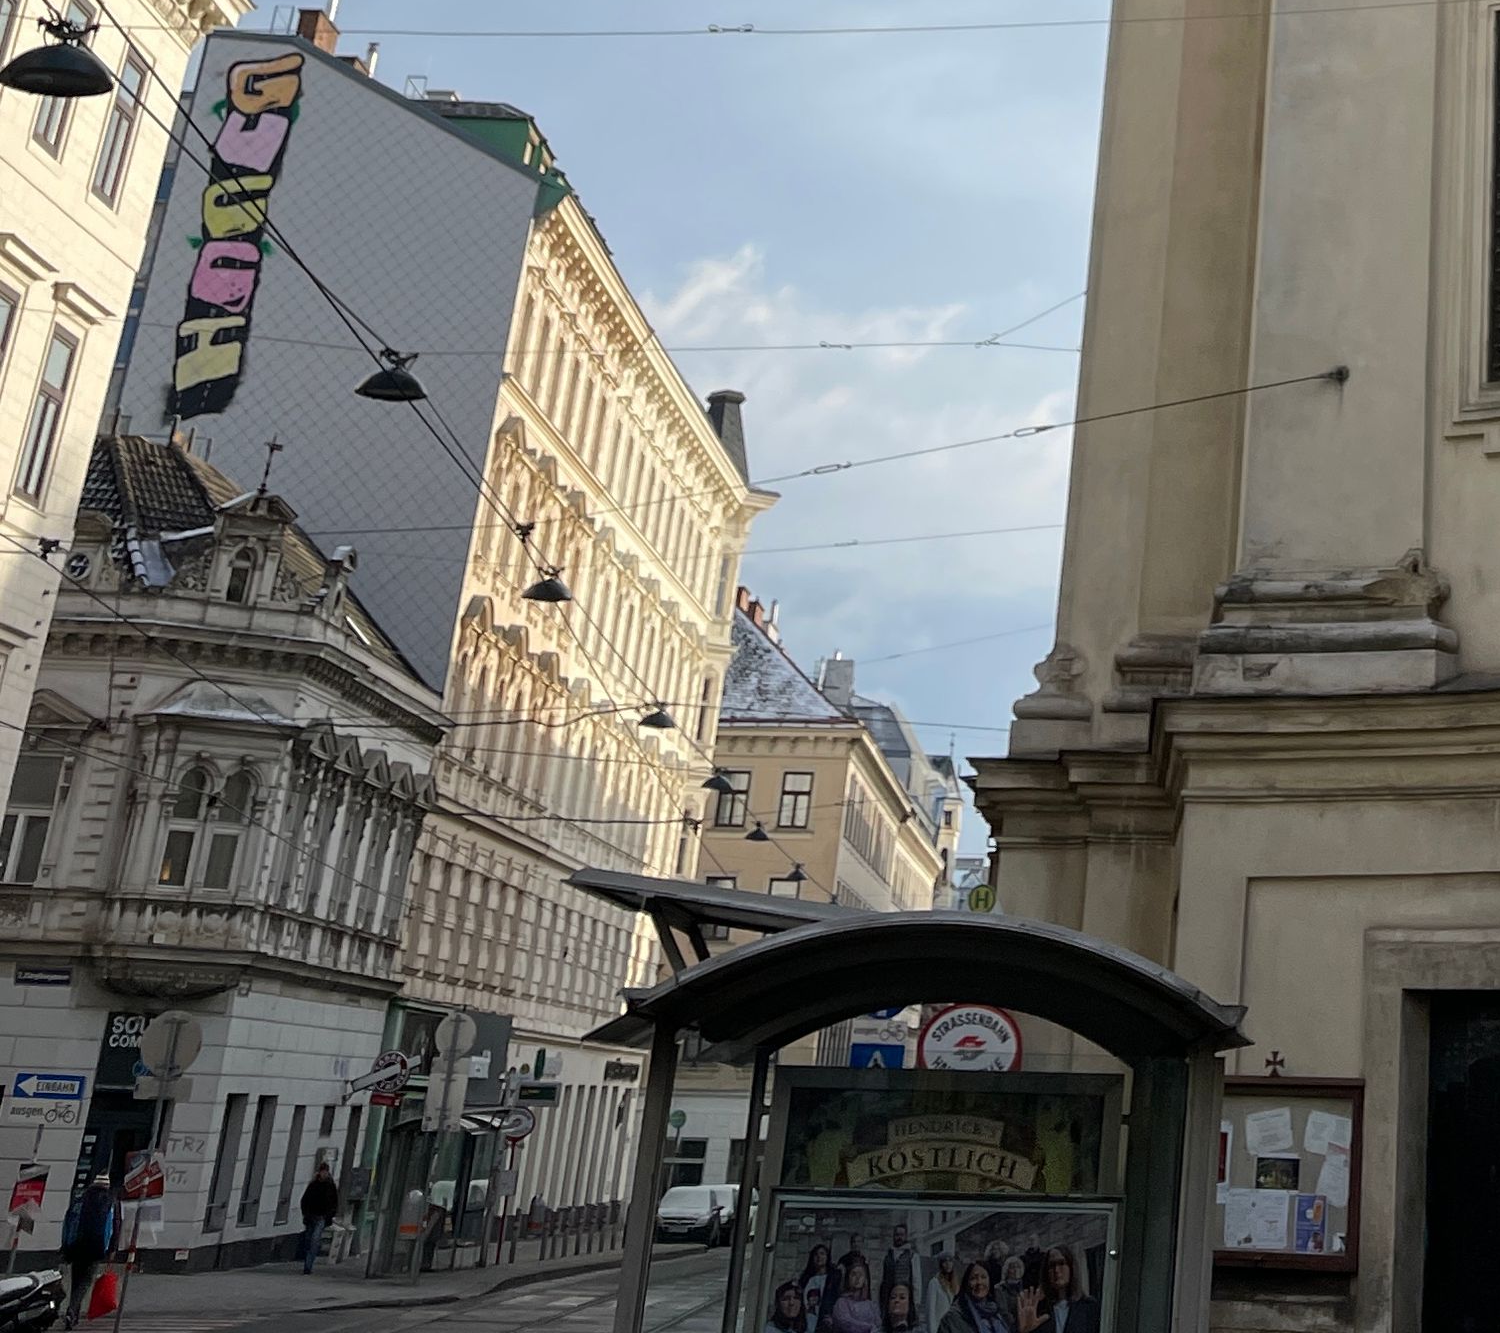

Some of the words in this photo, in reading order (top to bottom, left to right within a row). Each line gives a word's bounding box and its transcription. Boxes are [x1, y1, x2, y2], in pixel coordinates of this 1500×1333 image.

[975, 890, 989, 909] H
[931, 1012, 1011, 1045] STRASSENBAHN
[36, 1081, 76, 1094] EINBAHN
